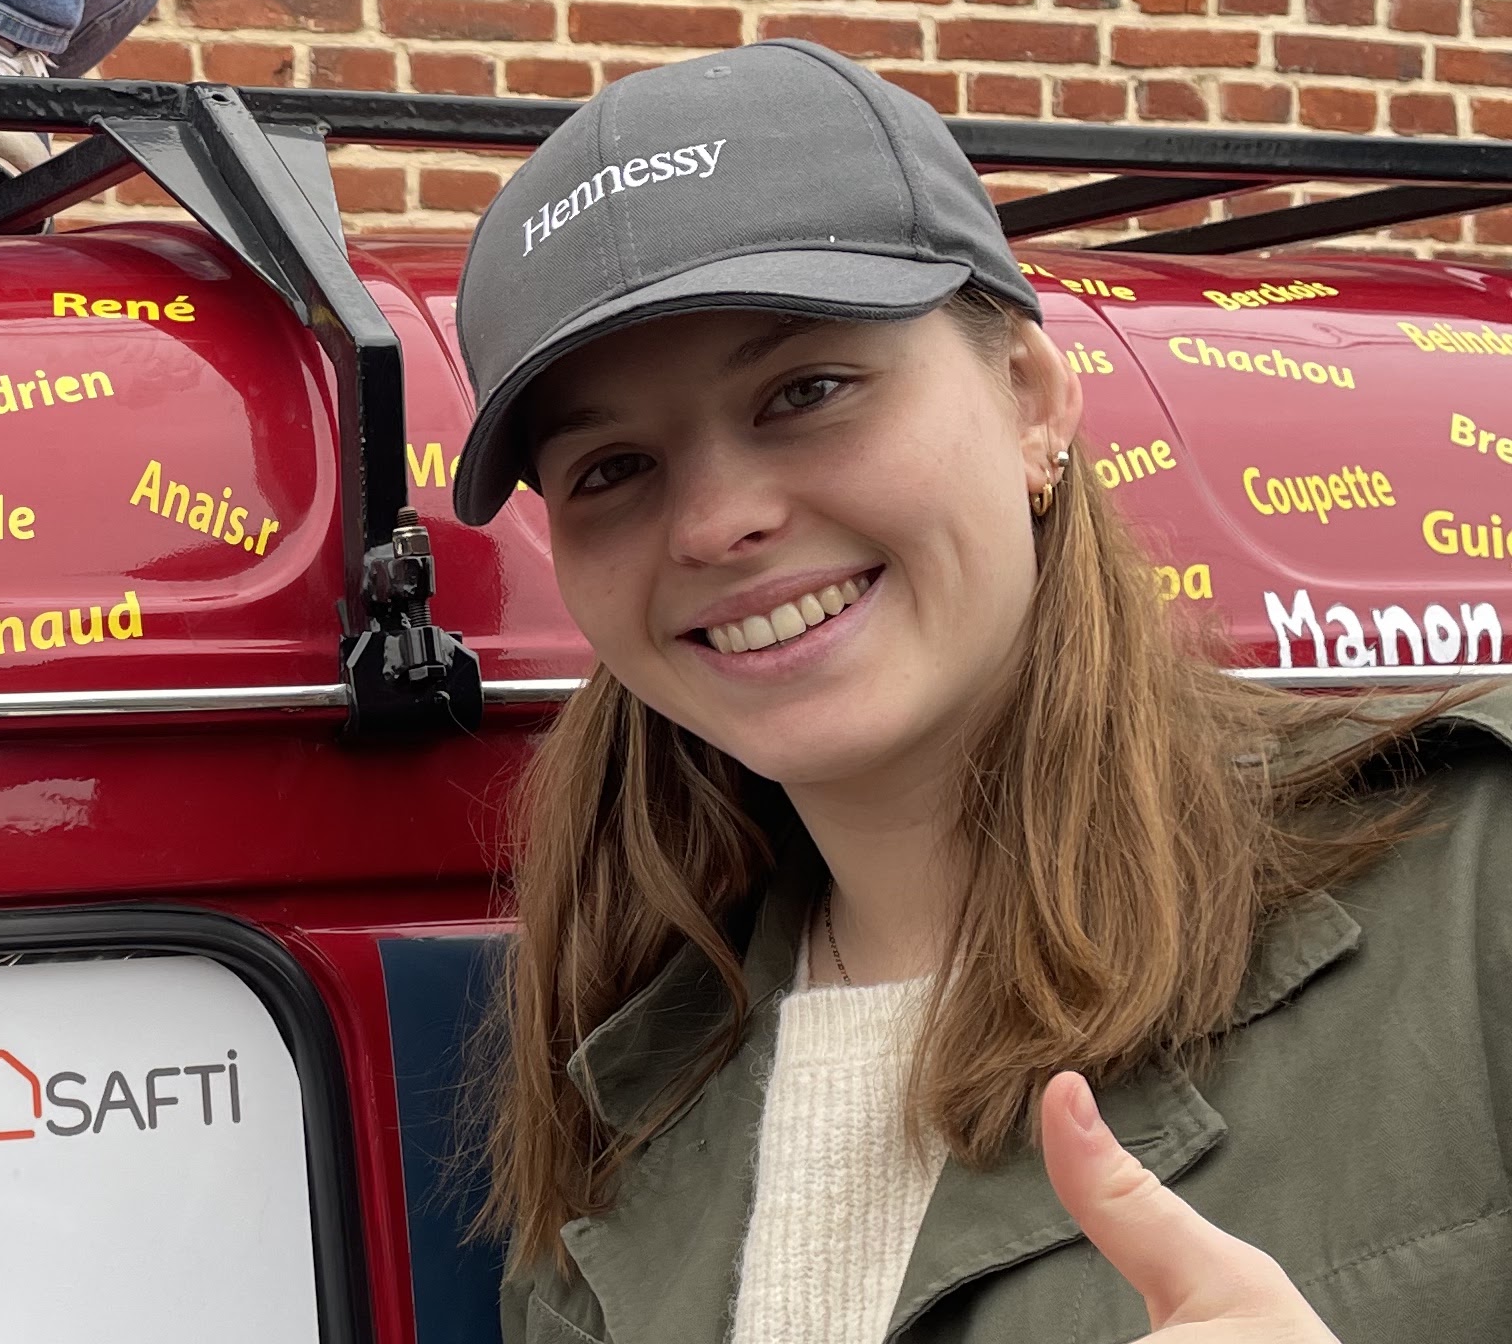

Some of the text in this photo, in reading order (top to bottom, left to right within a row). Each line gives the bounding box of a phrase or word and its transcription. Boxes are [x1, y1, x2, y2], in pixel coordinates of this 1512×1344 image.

[522, 138, 727, 257] Hennessy
[52, 292, 196, 322] René
[1202, 280, 1339, 311] Berckois
[1167, 337, 1356, 389] Chachou
[129, 459, 280, 557] Anais.r
[1241, 465, 1397, 525] Coupette
[1421, 509, 1512, 560] Gui
[1263, 588, 1504, 668] Manon
